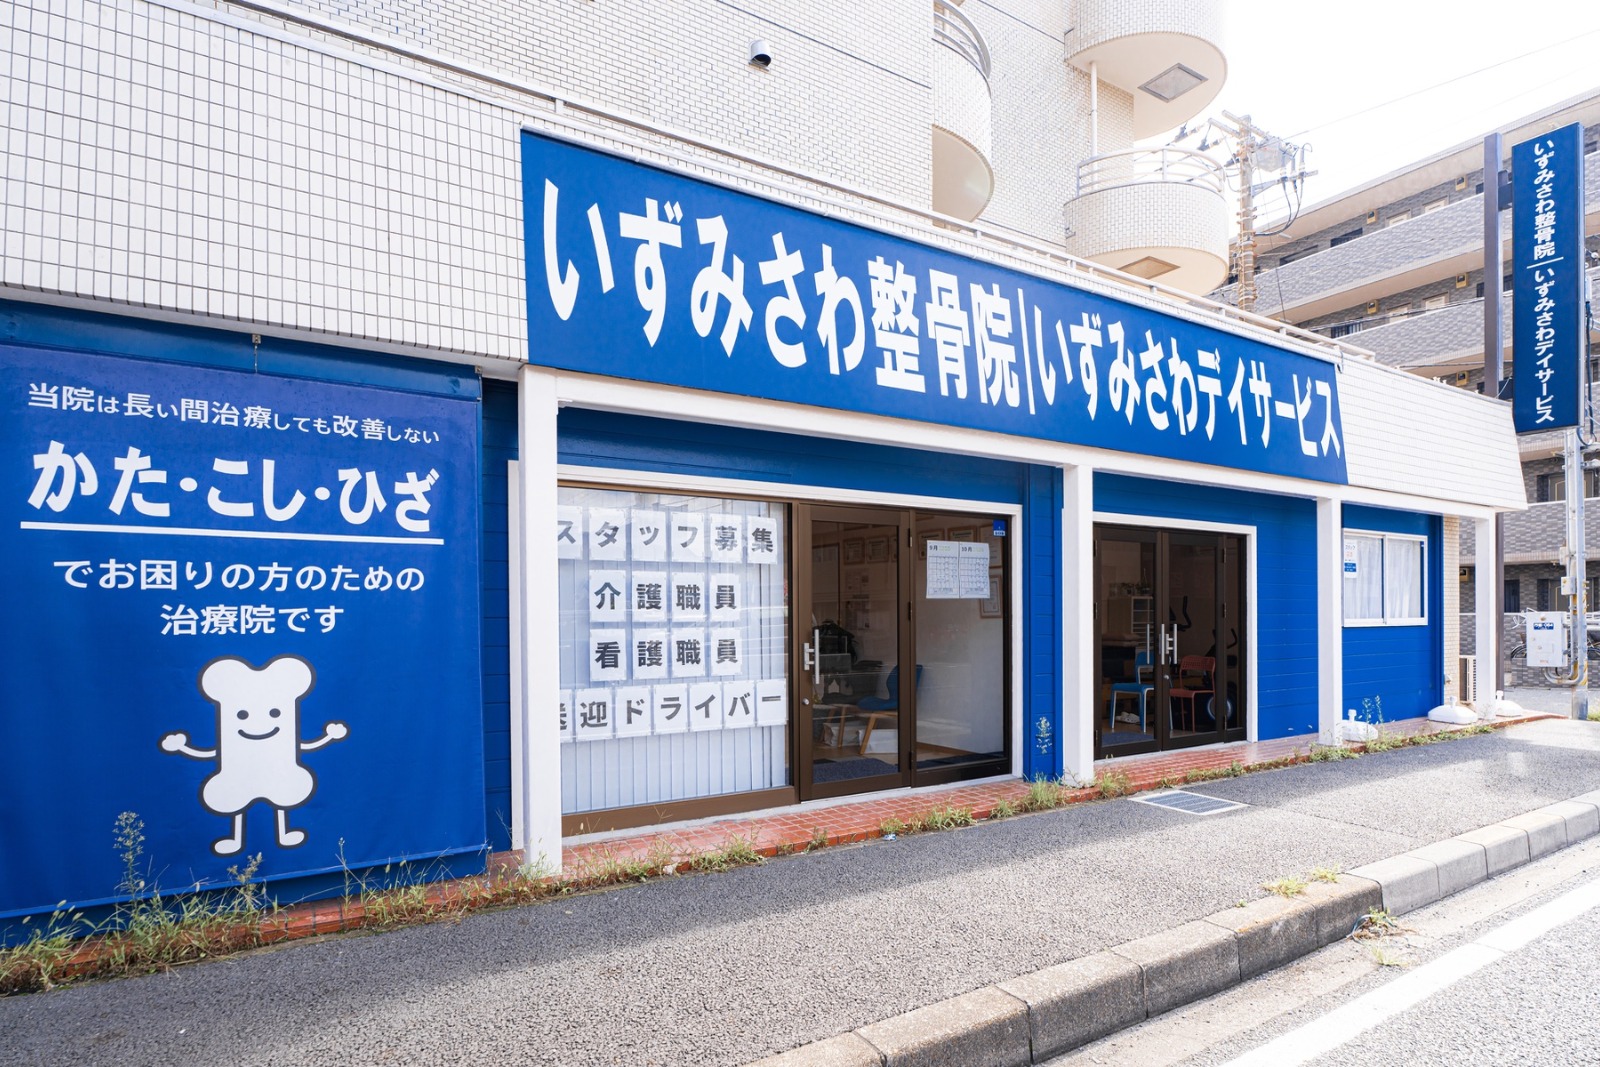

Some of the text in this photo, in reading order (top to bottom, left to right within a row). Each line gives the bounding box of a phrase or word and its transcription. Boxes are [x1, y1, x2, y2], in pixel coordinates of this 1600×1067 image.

[1534, 139, 1556, 424] いずみさわ整骨院 いずみさわデイサービス
[28, 382, 440, 444] 当院は長い間治療しても改善しない
[27, 440, 440, 533] かた・こし・ひざ
[557, 520, 774, 553] スタッフ募集
[54, 558, 425, 592] でお困りの方のための
[594, 582, 737, 611] 介護職員
[160, 604, 344, 636] 治療院です
[595, 639, 738, 669] 看護職員
[560, 692, 782, 730] 迎ドライバー
